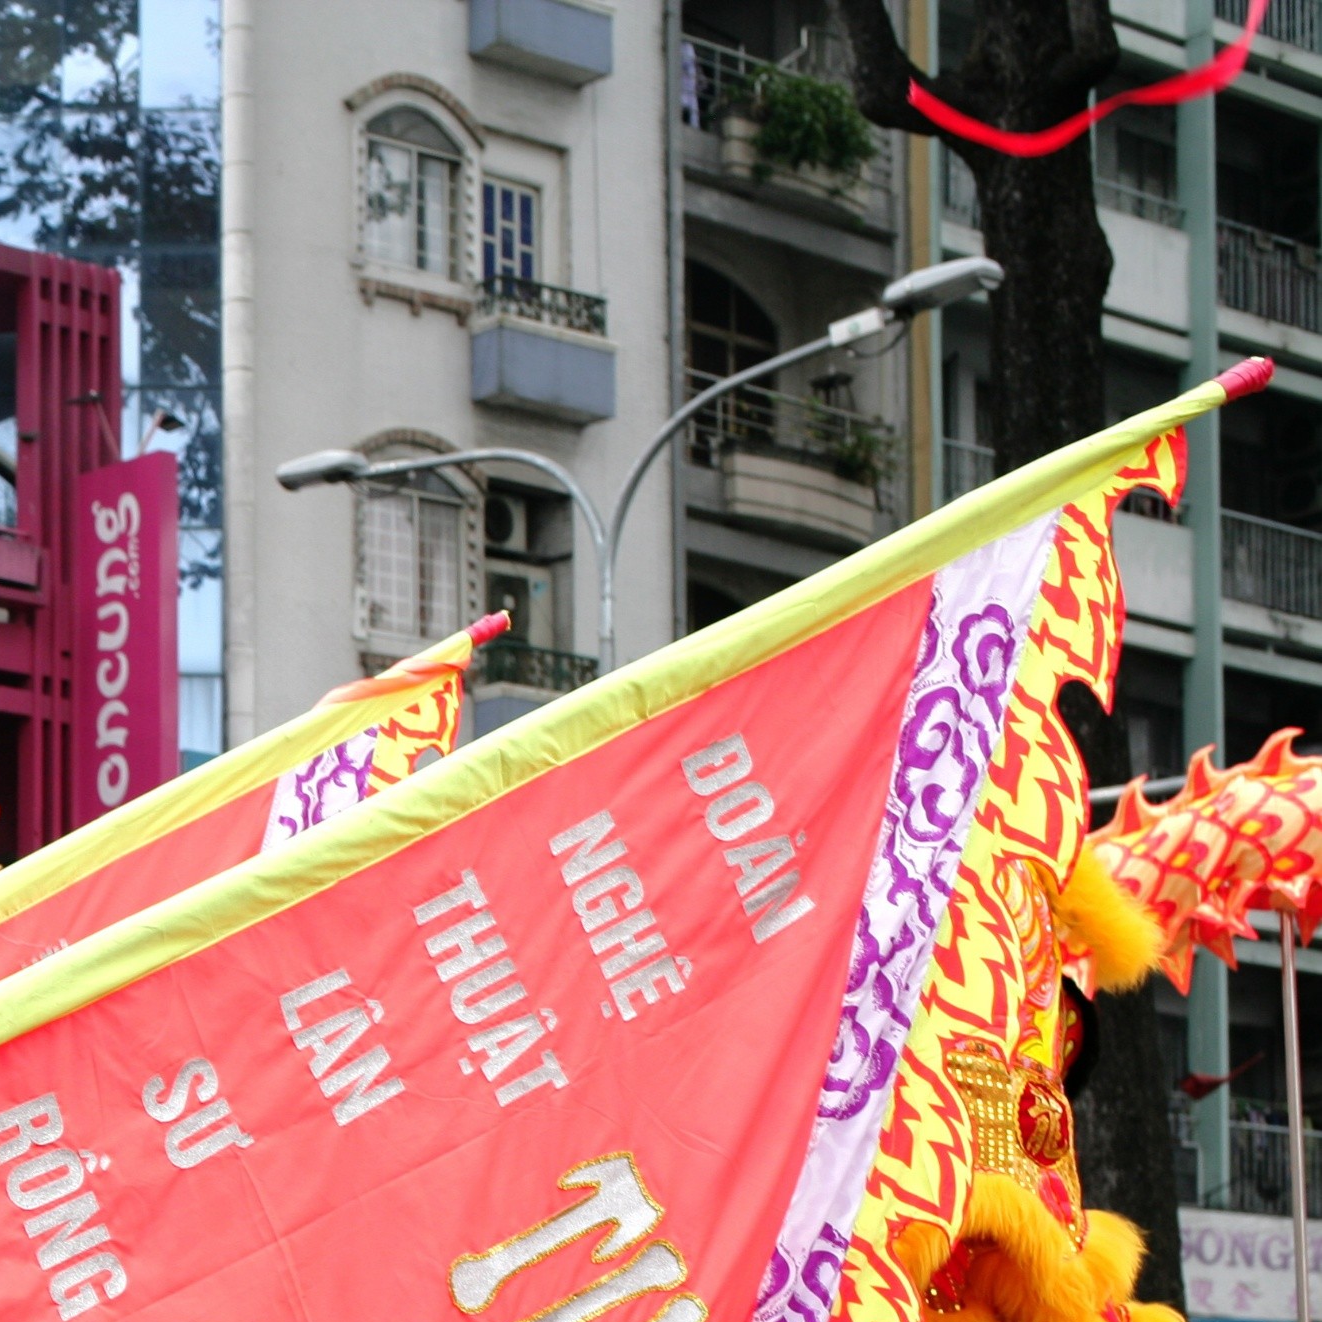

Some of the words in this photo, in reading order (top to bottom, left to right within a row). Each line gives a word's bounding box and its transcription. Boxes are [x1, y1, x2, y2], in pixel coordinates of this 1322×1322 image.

[92, 492, 141, 807] oncung
[548, 809, 693, 1022] NGHỆ
[681, 732, 817, 945] ĐOÀN
[278, 969, 406, 1127] LÂN
[413, 868, 570, 1108] THUẬT
[142, 1056, 256, 1169] SƯ
